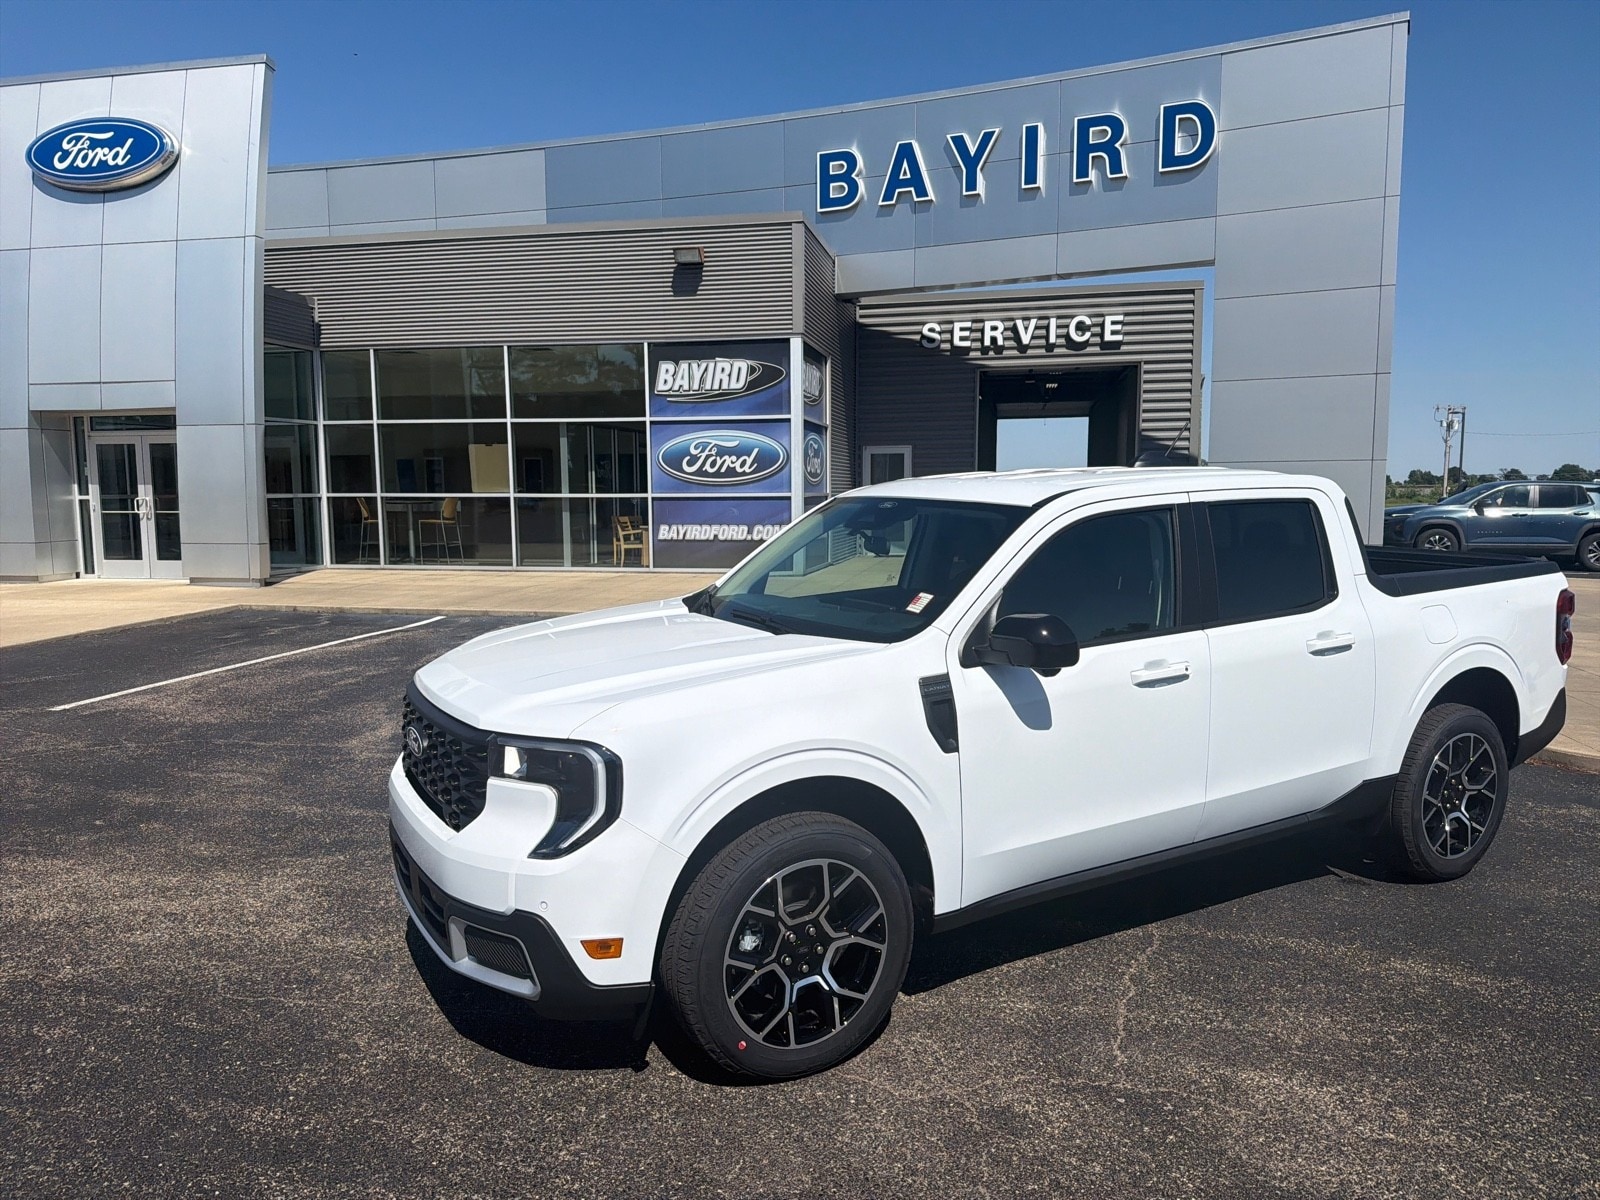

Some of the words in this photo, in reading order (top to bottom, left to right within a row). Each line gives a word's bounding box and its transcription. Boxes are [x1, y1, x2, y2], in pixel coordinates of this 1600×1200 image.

[53, 131, 134, 170] Ford
[816, 99, 1218, 214] BAYIRD
[921, 314, 1125, 350] SERVICE
[655, 359, 750, 395] BAYIRD
[682, 438, 759, 473] Ford
[807, 440, 821, 475] Ford
